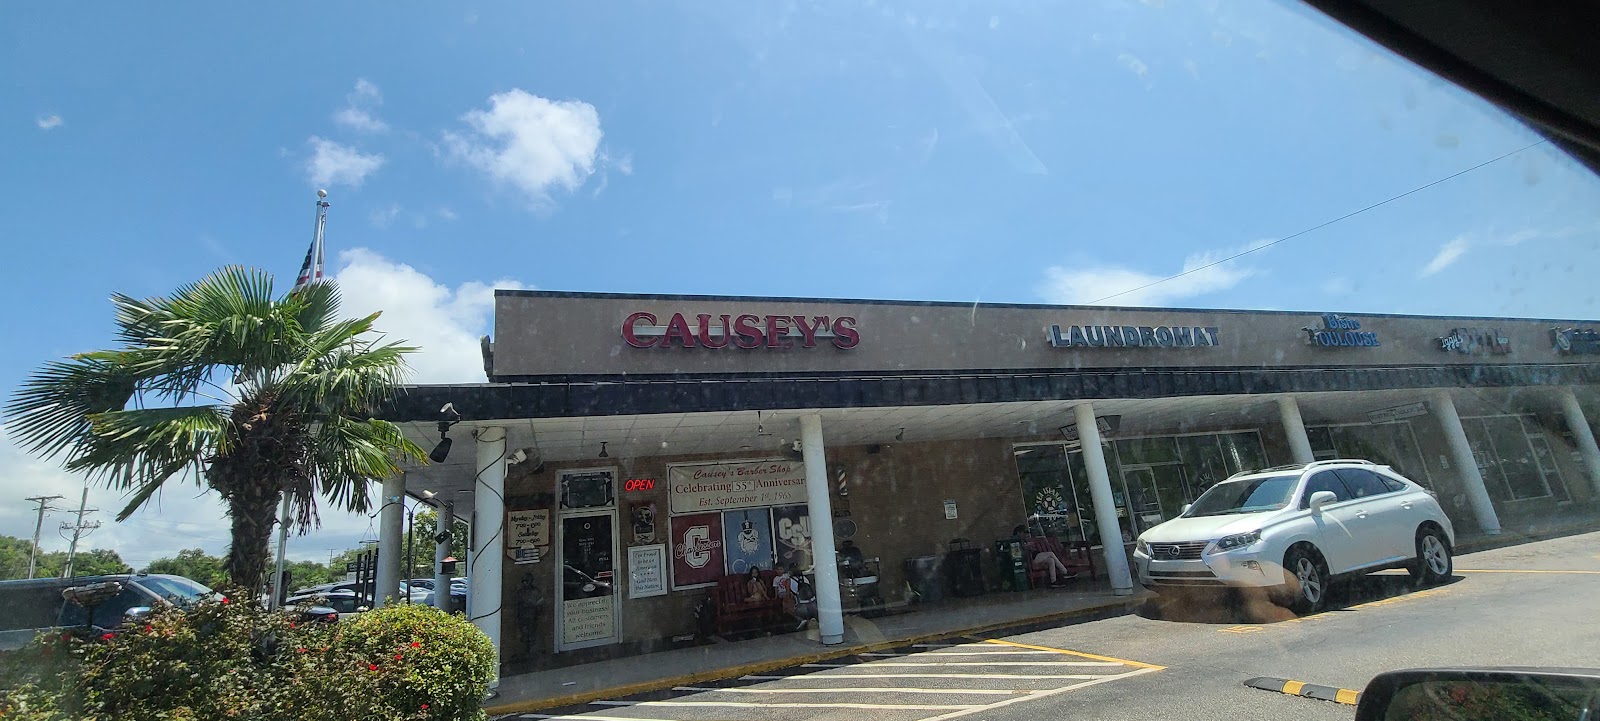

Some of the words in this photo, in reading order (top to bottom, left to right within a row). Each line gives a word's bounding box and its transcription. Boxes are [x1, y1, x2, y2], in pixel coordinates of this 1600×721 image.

[1326, 314, 1361, 329] Bistro
[621, 311, 860, 349] CAUSEY'S
[1048, 324, 1219, 347] LAUNDROMAT
[1307, 328, 1381, 346] TOULOUSE
[693, 467, 734, 479] Causey's
[736, 465, 767, 476] Barber
[769, 464, 791, 475] Shop
[625, 478, 655, 492] OPEN
[675, 482, 732, 494] Celebrating
[698, 497, 718, 506] Est.
[721, 494, 758, 507] September
[584, 622, 606, 630] friends
